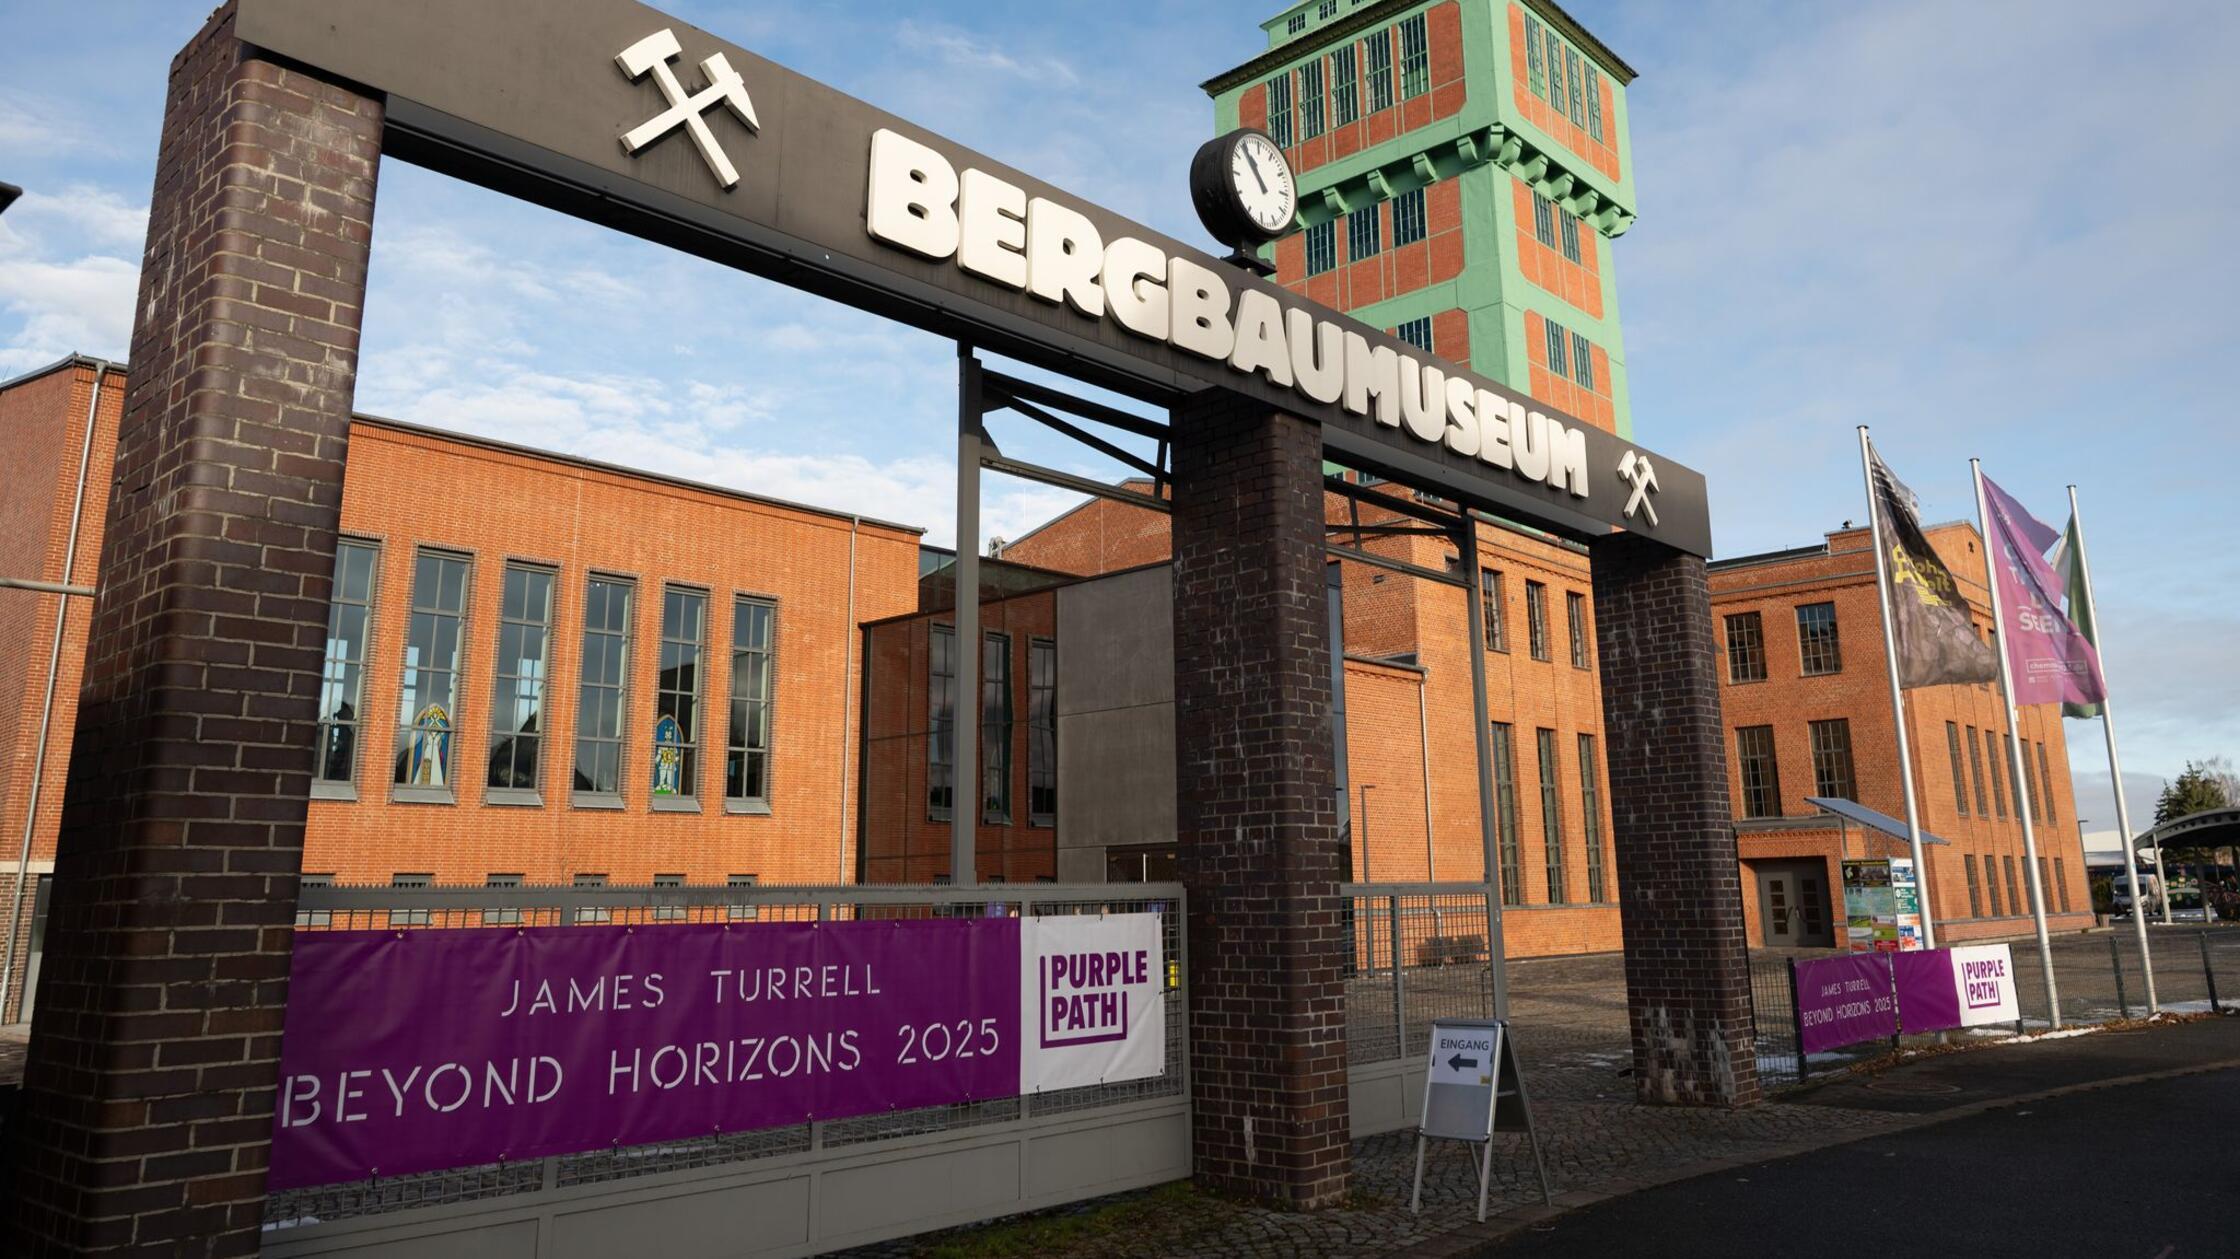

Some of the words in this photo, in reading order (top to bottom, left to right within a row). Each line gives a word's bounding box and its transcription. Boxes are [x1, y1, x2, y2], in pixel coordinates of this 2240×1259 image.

[867, 128, 1589, 499] BERGBAUMUSEUM
[1052, 950, 1148, 990] PURPLE
[1966, 960, 2005, 980] PURPLE
[501, 973, 665, 1017] JAMES
[711, 964, 881, 1004] TURRELL
[1821, 982, 1842, 998] JAMES
[1845, 978, 1871, 993] TURRELL
[1969, 981, 1996, 1001] PATH
[1052, 993, 1118, 1033] PATH
[1803, 1007, 1833, 1027] BEYOND
[1836, 1000, 1872, 1019] HORIZONS
[1874, 996, 1892, 1013] 2025
[1440, 1038, 1490, 1051] EINGANG
[281, 1055, 564, 1128] BEYOND
[608, 1029, 861, 1096] HORIZONS
[897, 1017, 1000, 1065] 2025
